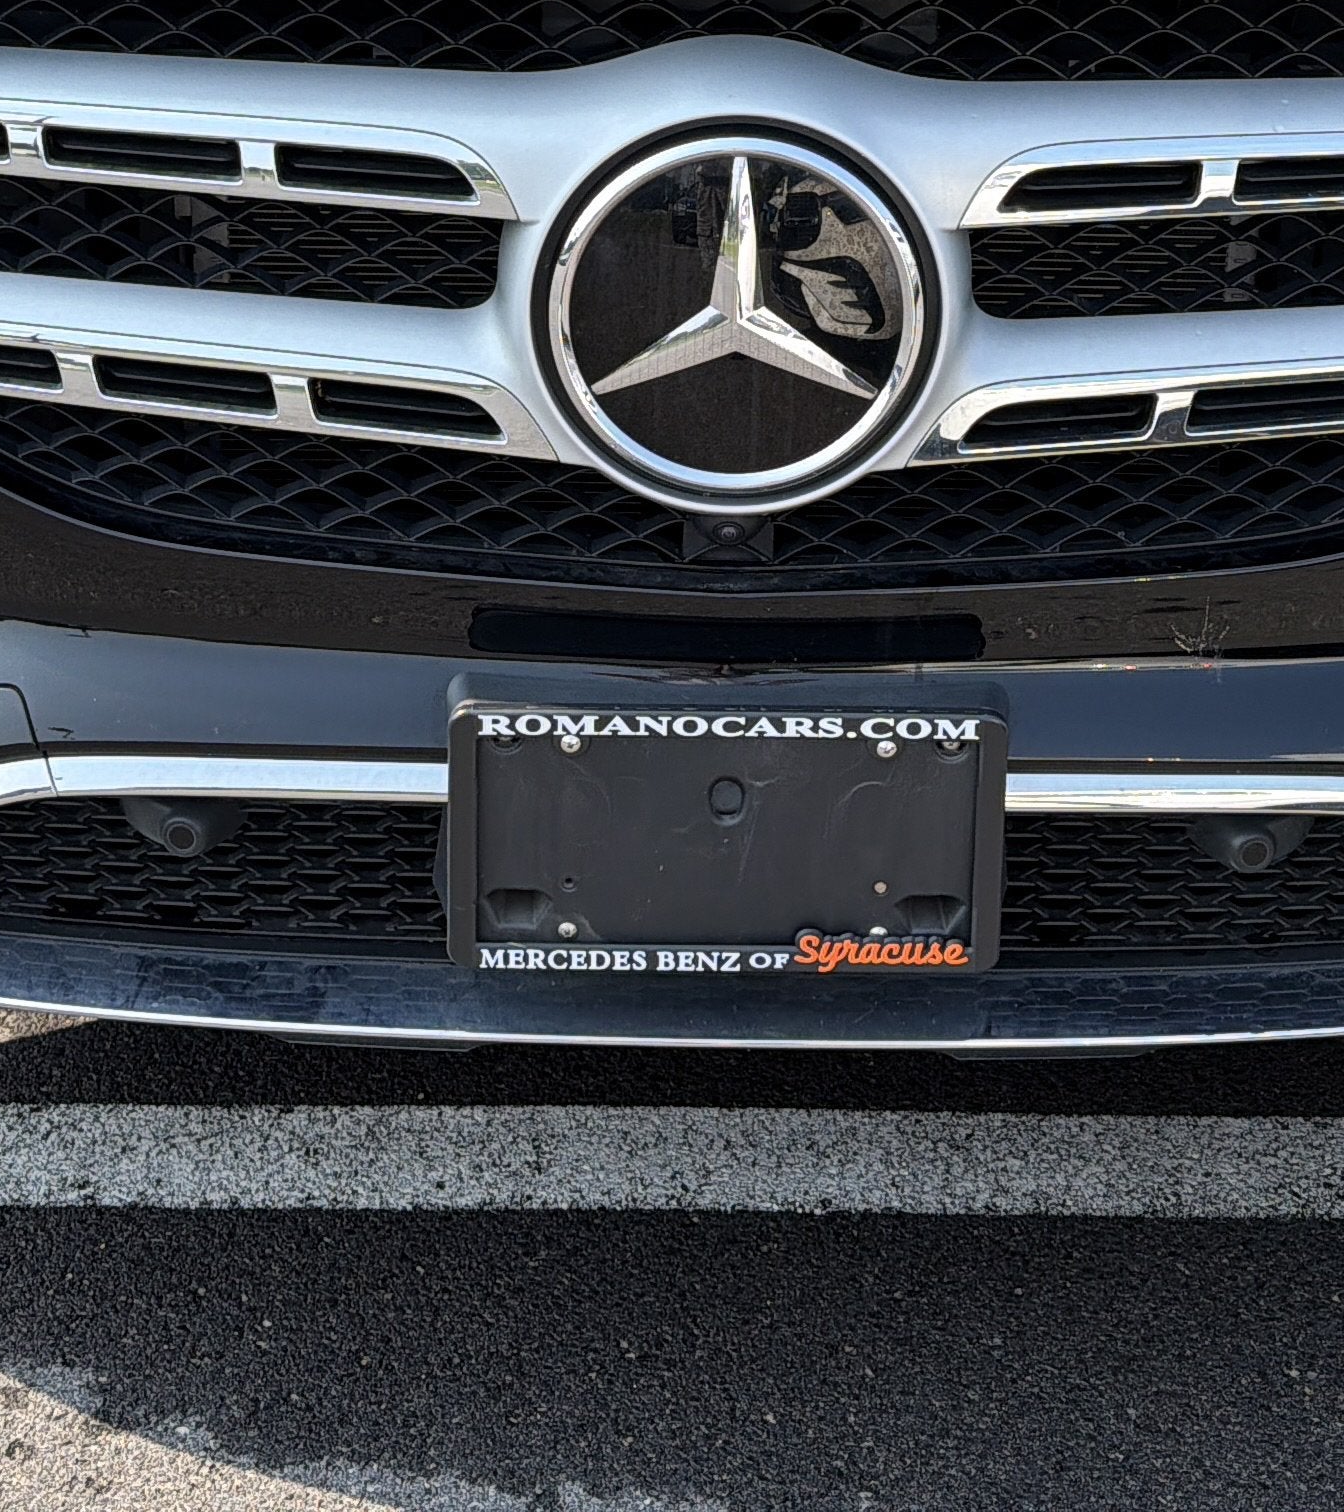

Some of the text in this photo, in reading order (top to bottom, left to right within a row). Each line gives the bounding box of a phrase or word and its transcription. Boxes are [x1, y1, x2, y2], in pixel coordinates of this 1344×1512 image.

[477, 714, 980, 740] ROMANOCARS.COM
[479, 934, 969, 973] MERCEDES BENZ OF Syracuse
